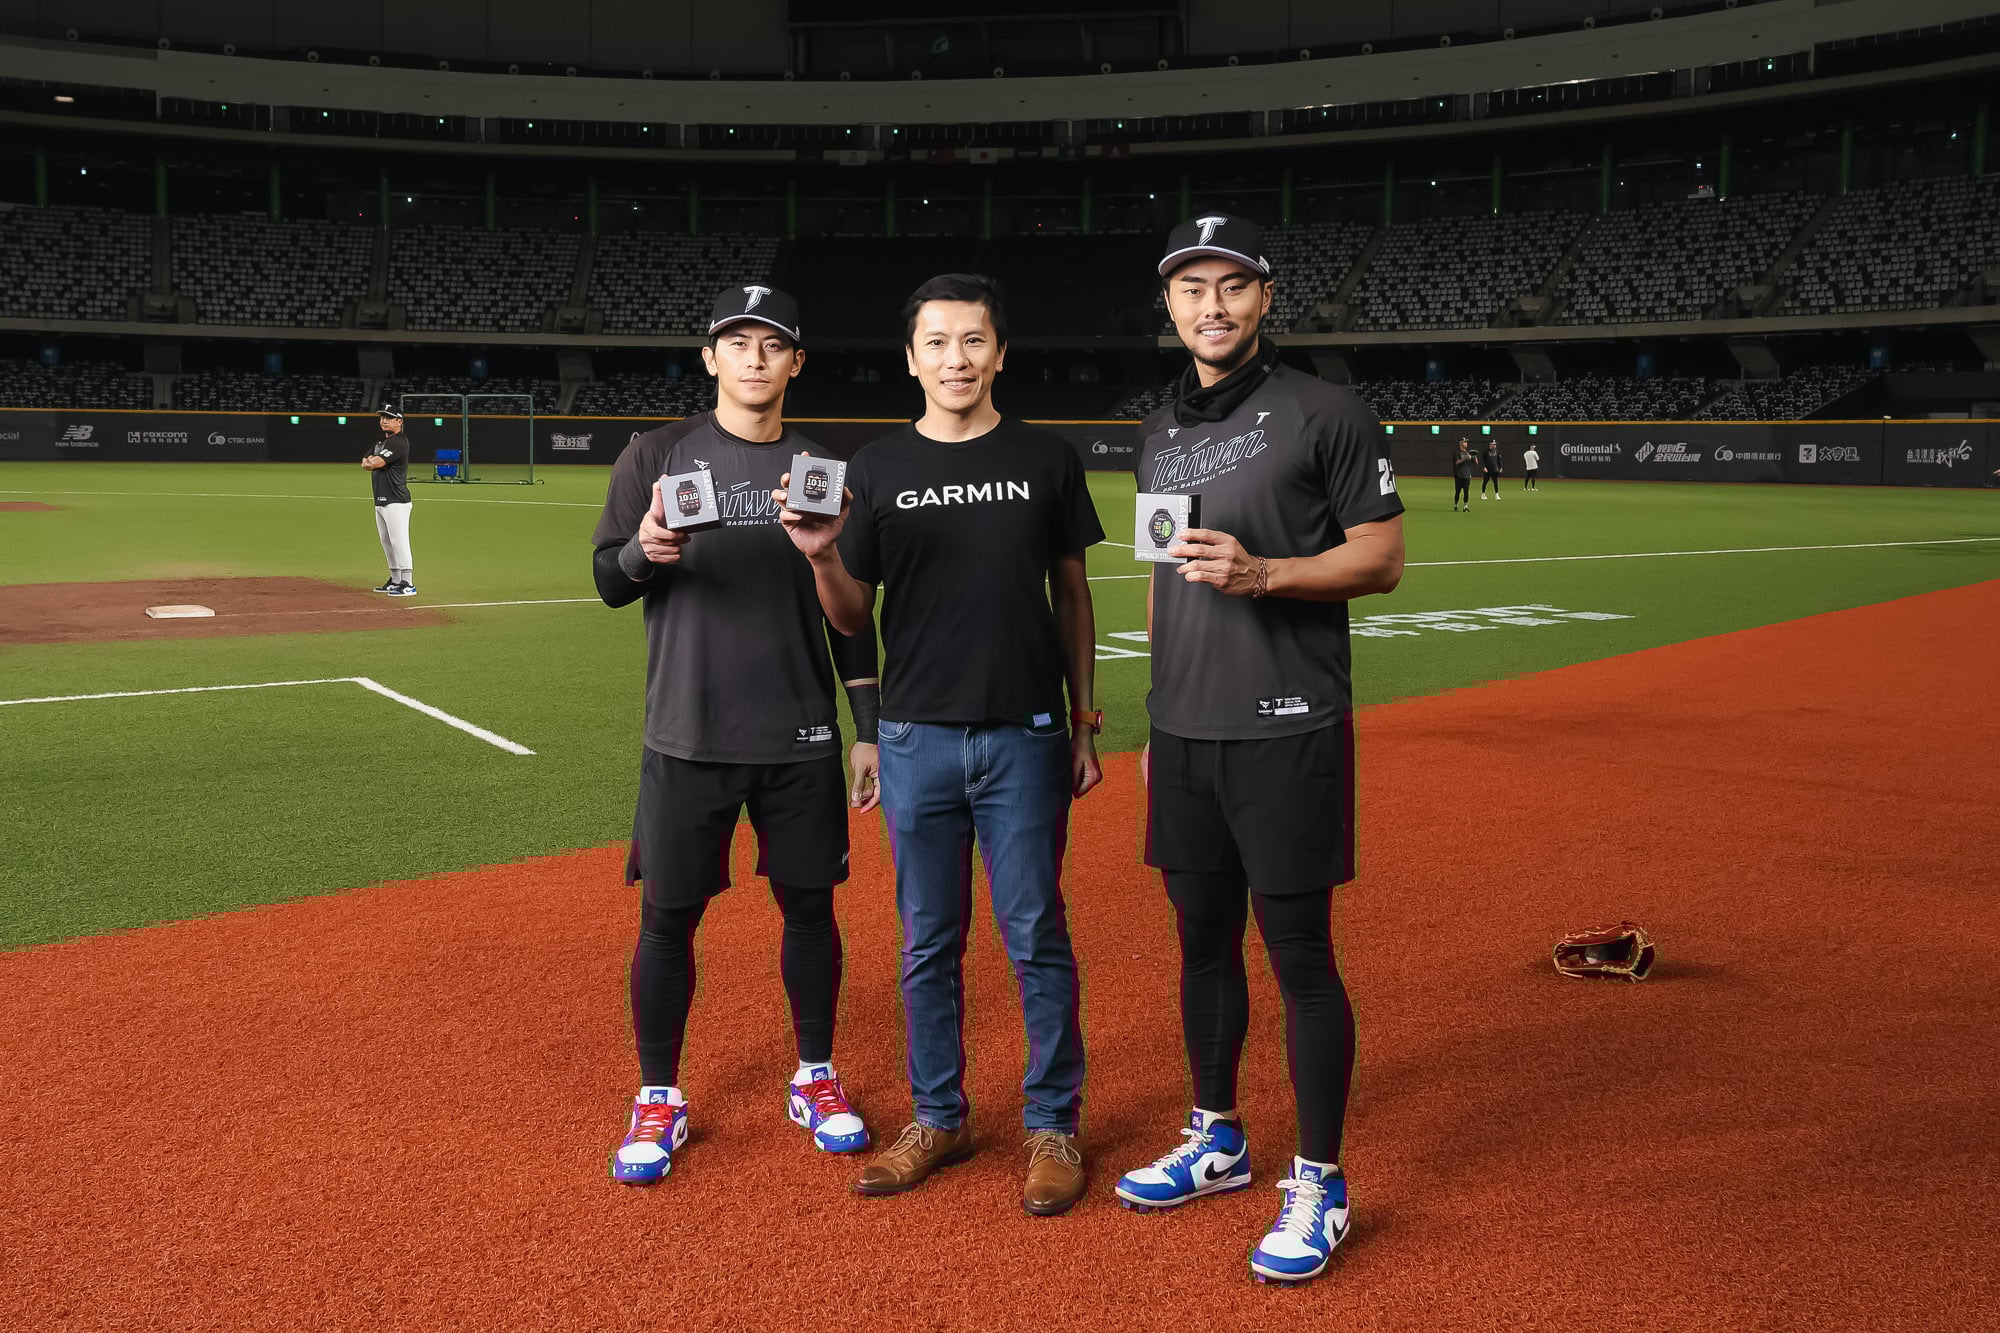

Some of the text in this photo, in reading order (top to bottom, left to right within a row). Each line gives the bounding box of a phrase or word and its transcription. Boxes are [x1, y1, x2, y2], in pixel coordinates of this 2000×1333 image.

[1196, 216, 1227, 247] T
[743, 286, 772, 313] T
[1256, 412, 1271, 425] T
[1560, 442, 1613, 456] Continental
[702, 469, 716, 510] GARMIN
[832, 462, 846, 504] GARMIN
[1180, 474, 1217, 489] BASEBALL
[1218, 464, 1238, 476] TEAM
[1377, 457, 1397, 496] 2
[896, 481, 1030, 510] GARMIN
[726, 519, 769, 527] BASEBALL
